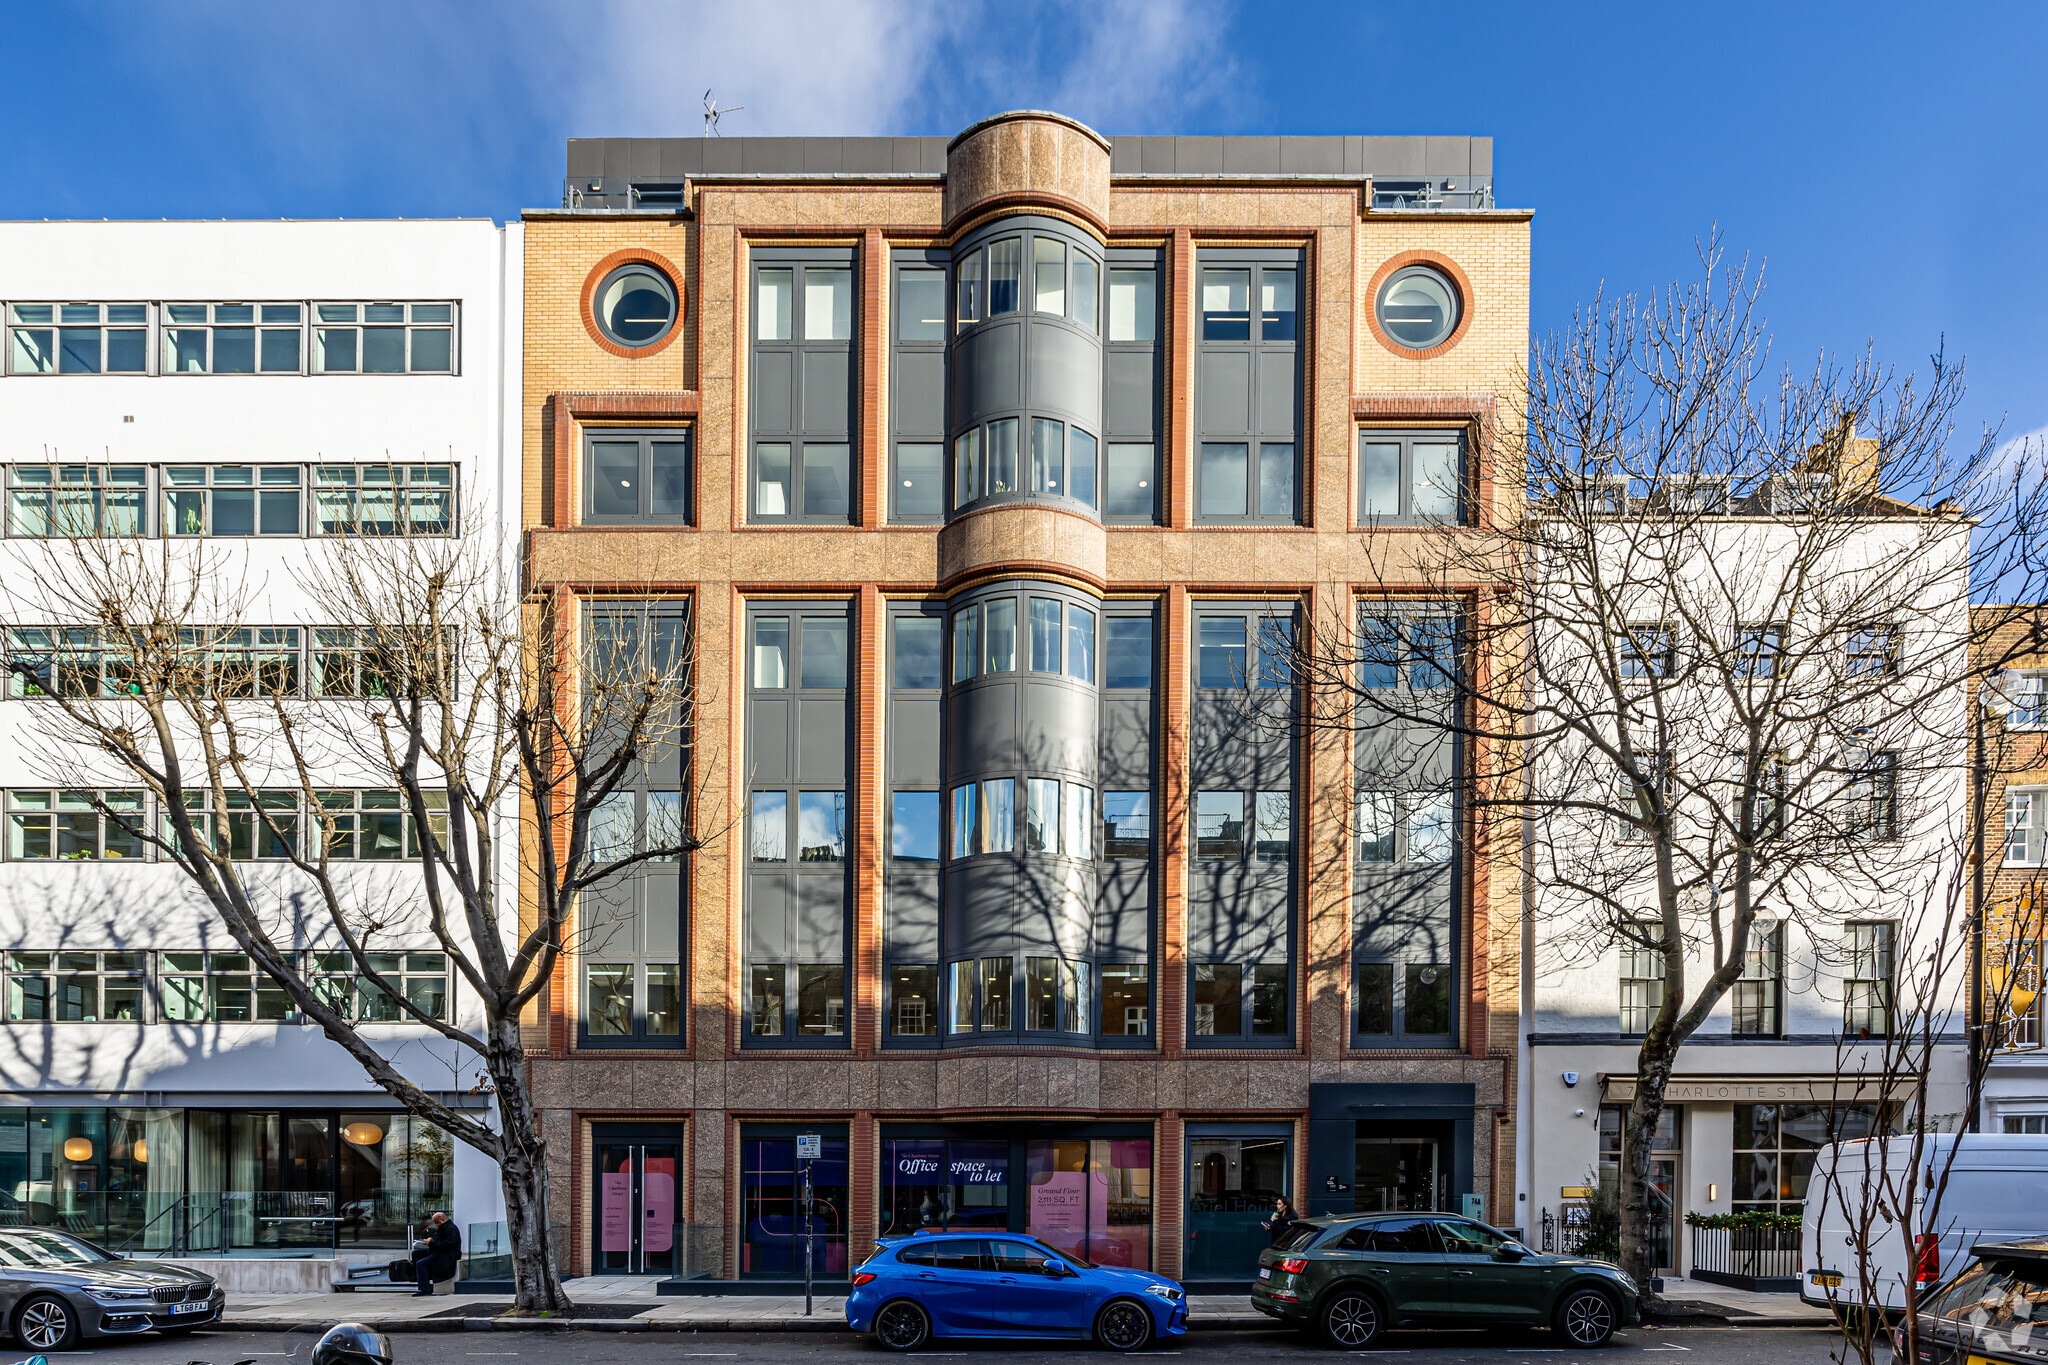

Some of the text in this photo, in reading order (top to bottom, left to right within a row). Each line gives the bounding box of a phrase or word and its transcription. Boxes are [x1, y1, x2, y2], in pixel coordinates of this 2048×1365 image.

[1668, 1086, 1767, 1098] HARLOTTE
[899, 1159, 986, 1175] Office space
[970, 1169, 1002, 1182] to let
[1191, 1199, 1277, 1213] Ariel Hous
[1471, 1197, 1481, 1205] 74A
